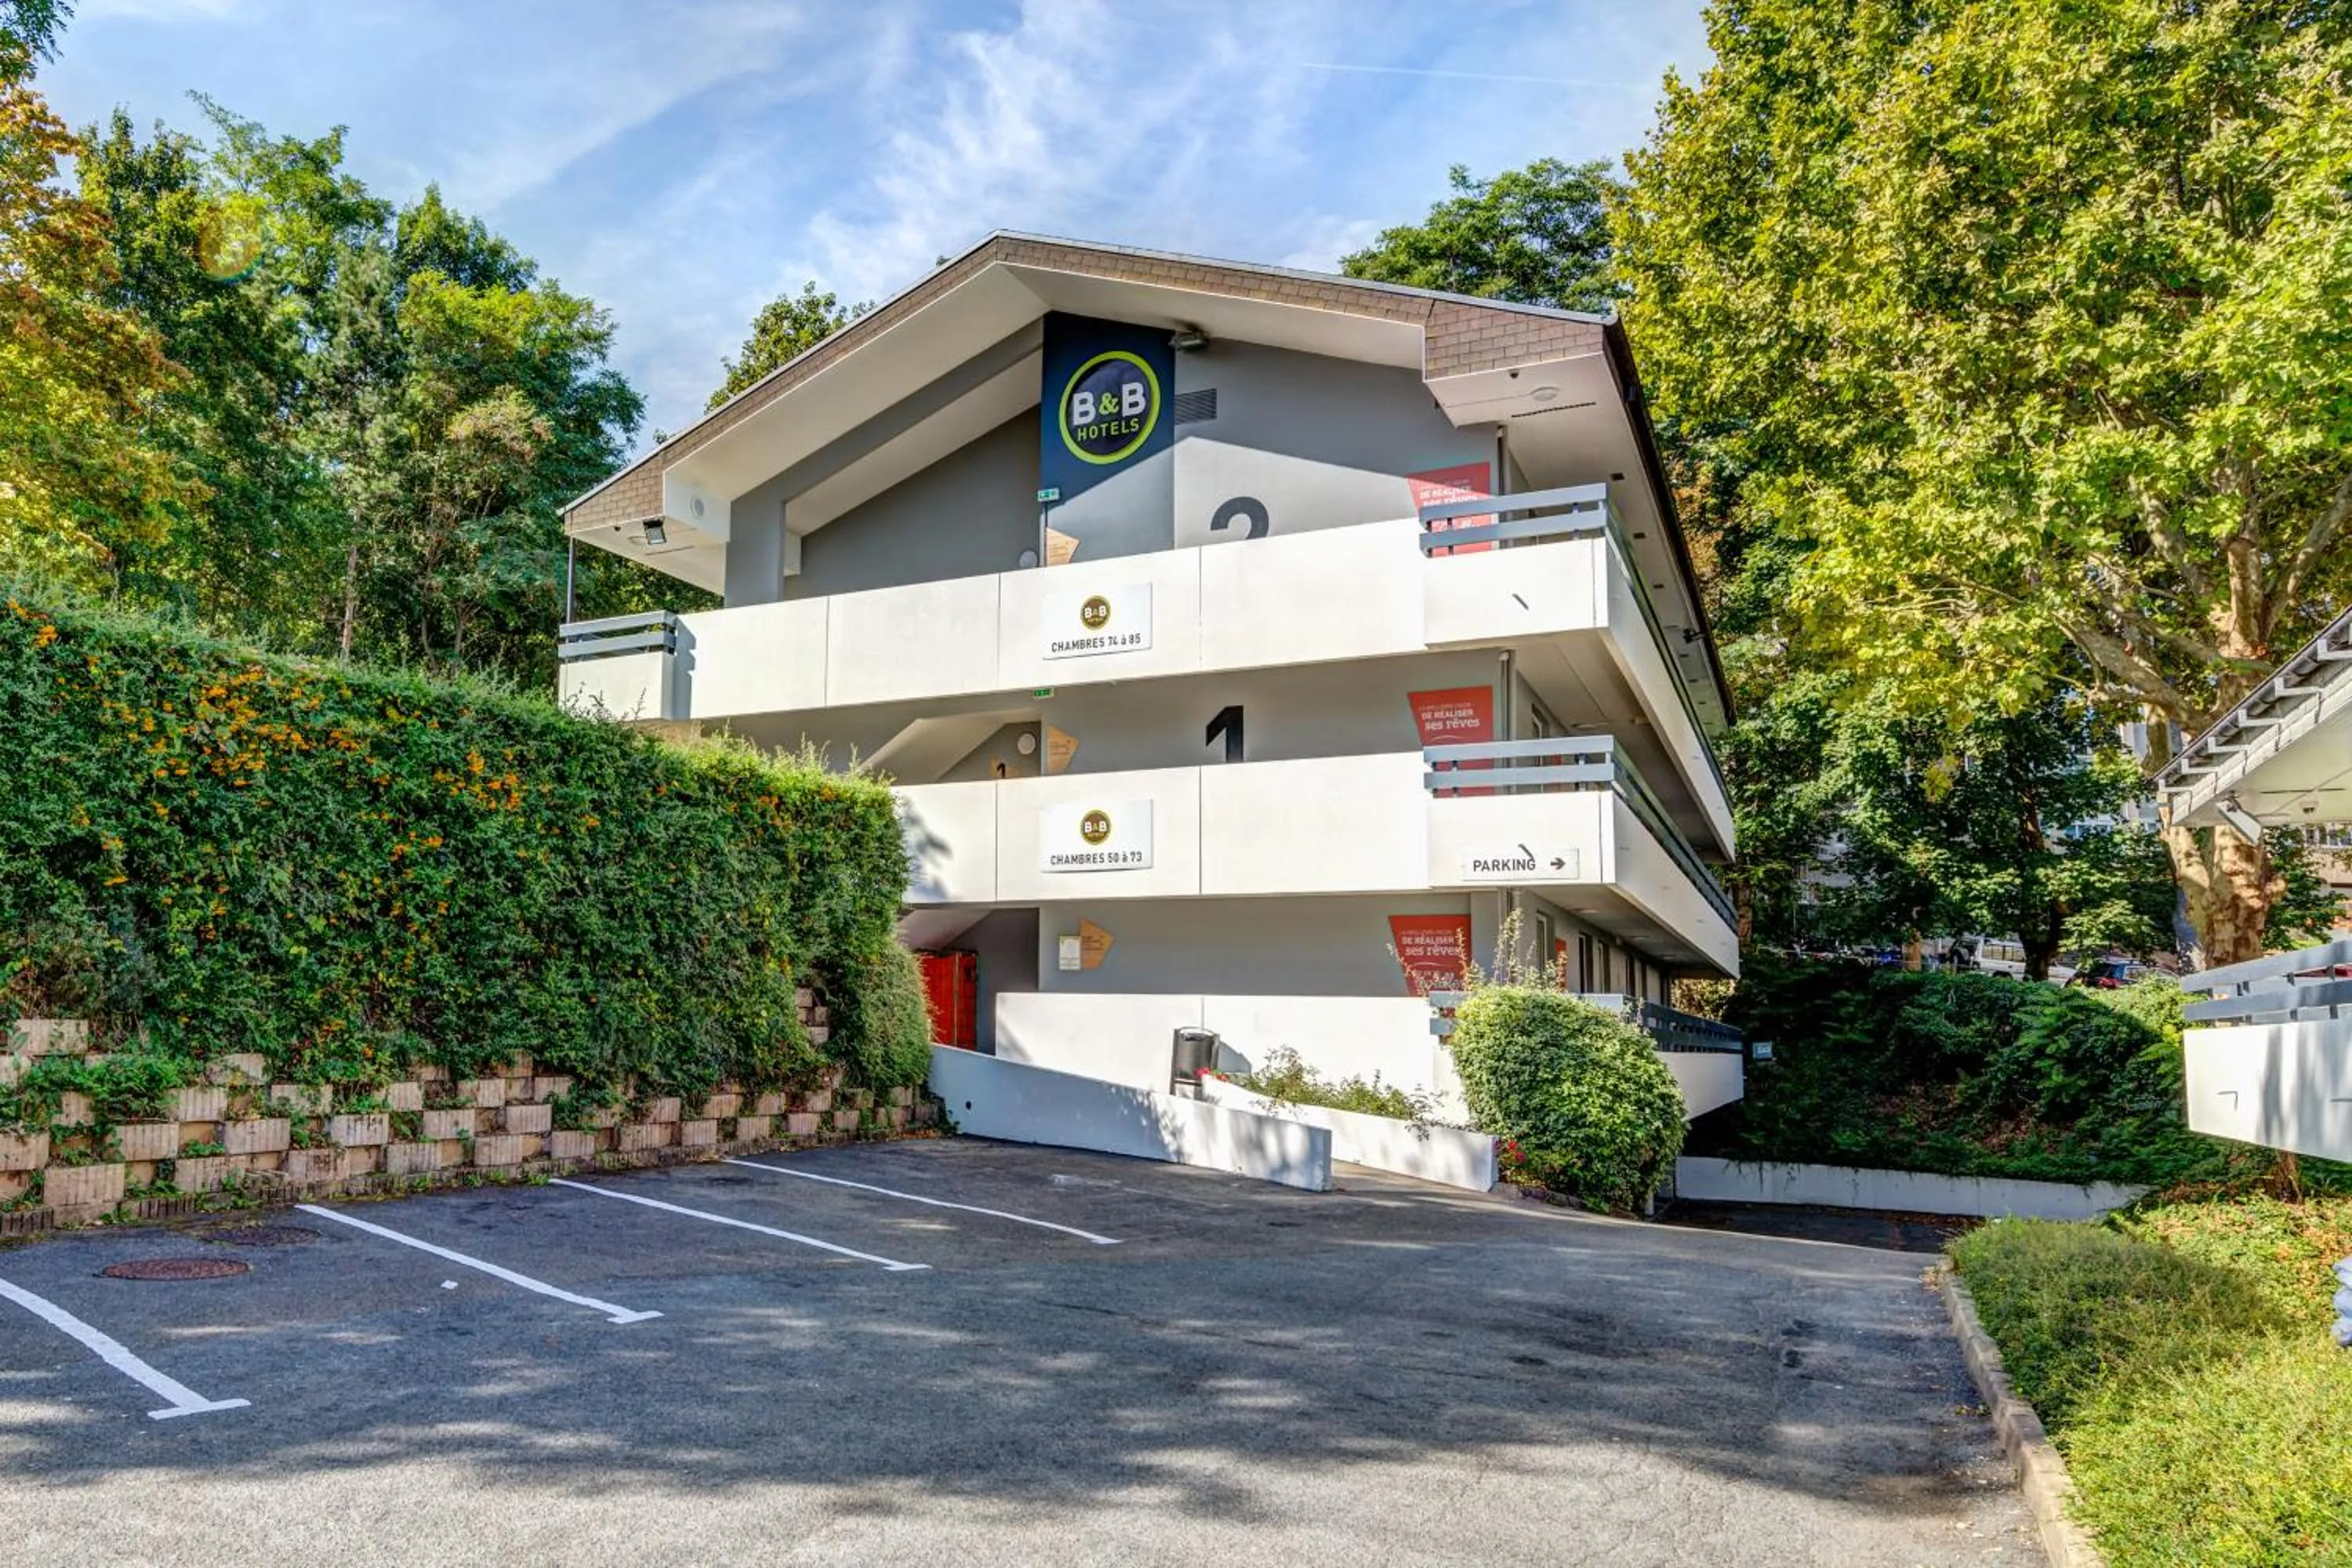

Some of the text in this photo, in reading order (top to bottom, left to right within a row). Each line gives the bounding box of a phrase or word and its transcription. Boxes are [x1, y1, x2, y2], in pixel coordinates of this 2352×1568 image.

[1073, 382, 1146, 426] B&B
[1078, 418, 1139, 441] HOTELS
[1051, 633, 1141, 653] CHAMBRES 74 à 85
[1206, 705, 1244, 762] 1
[1050, 852, 1105, 866] CHAMBRES
[1107, 852, 1120, 863] 50
[1130, 851, 1142, 862] 73
[1473, 858, 1536, 872] PARKING
